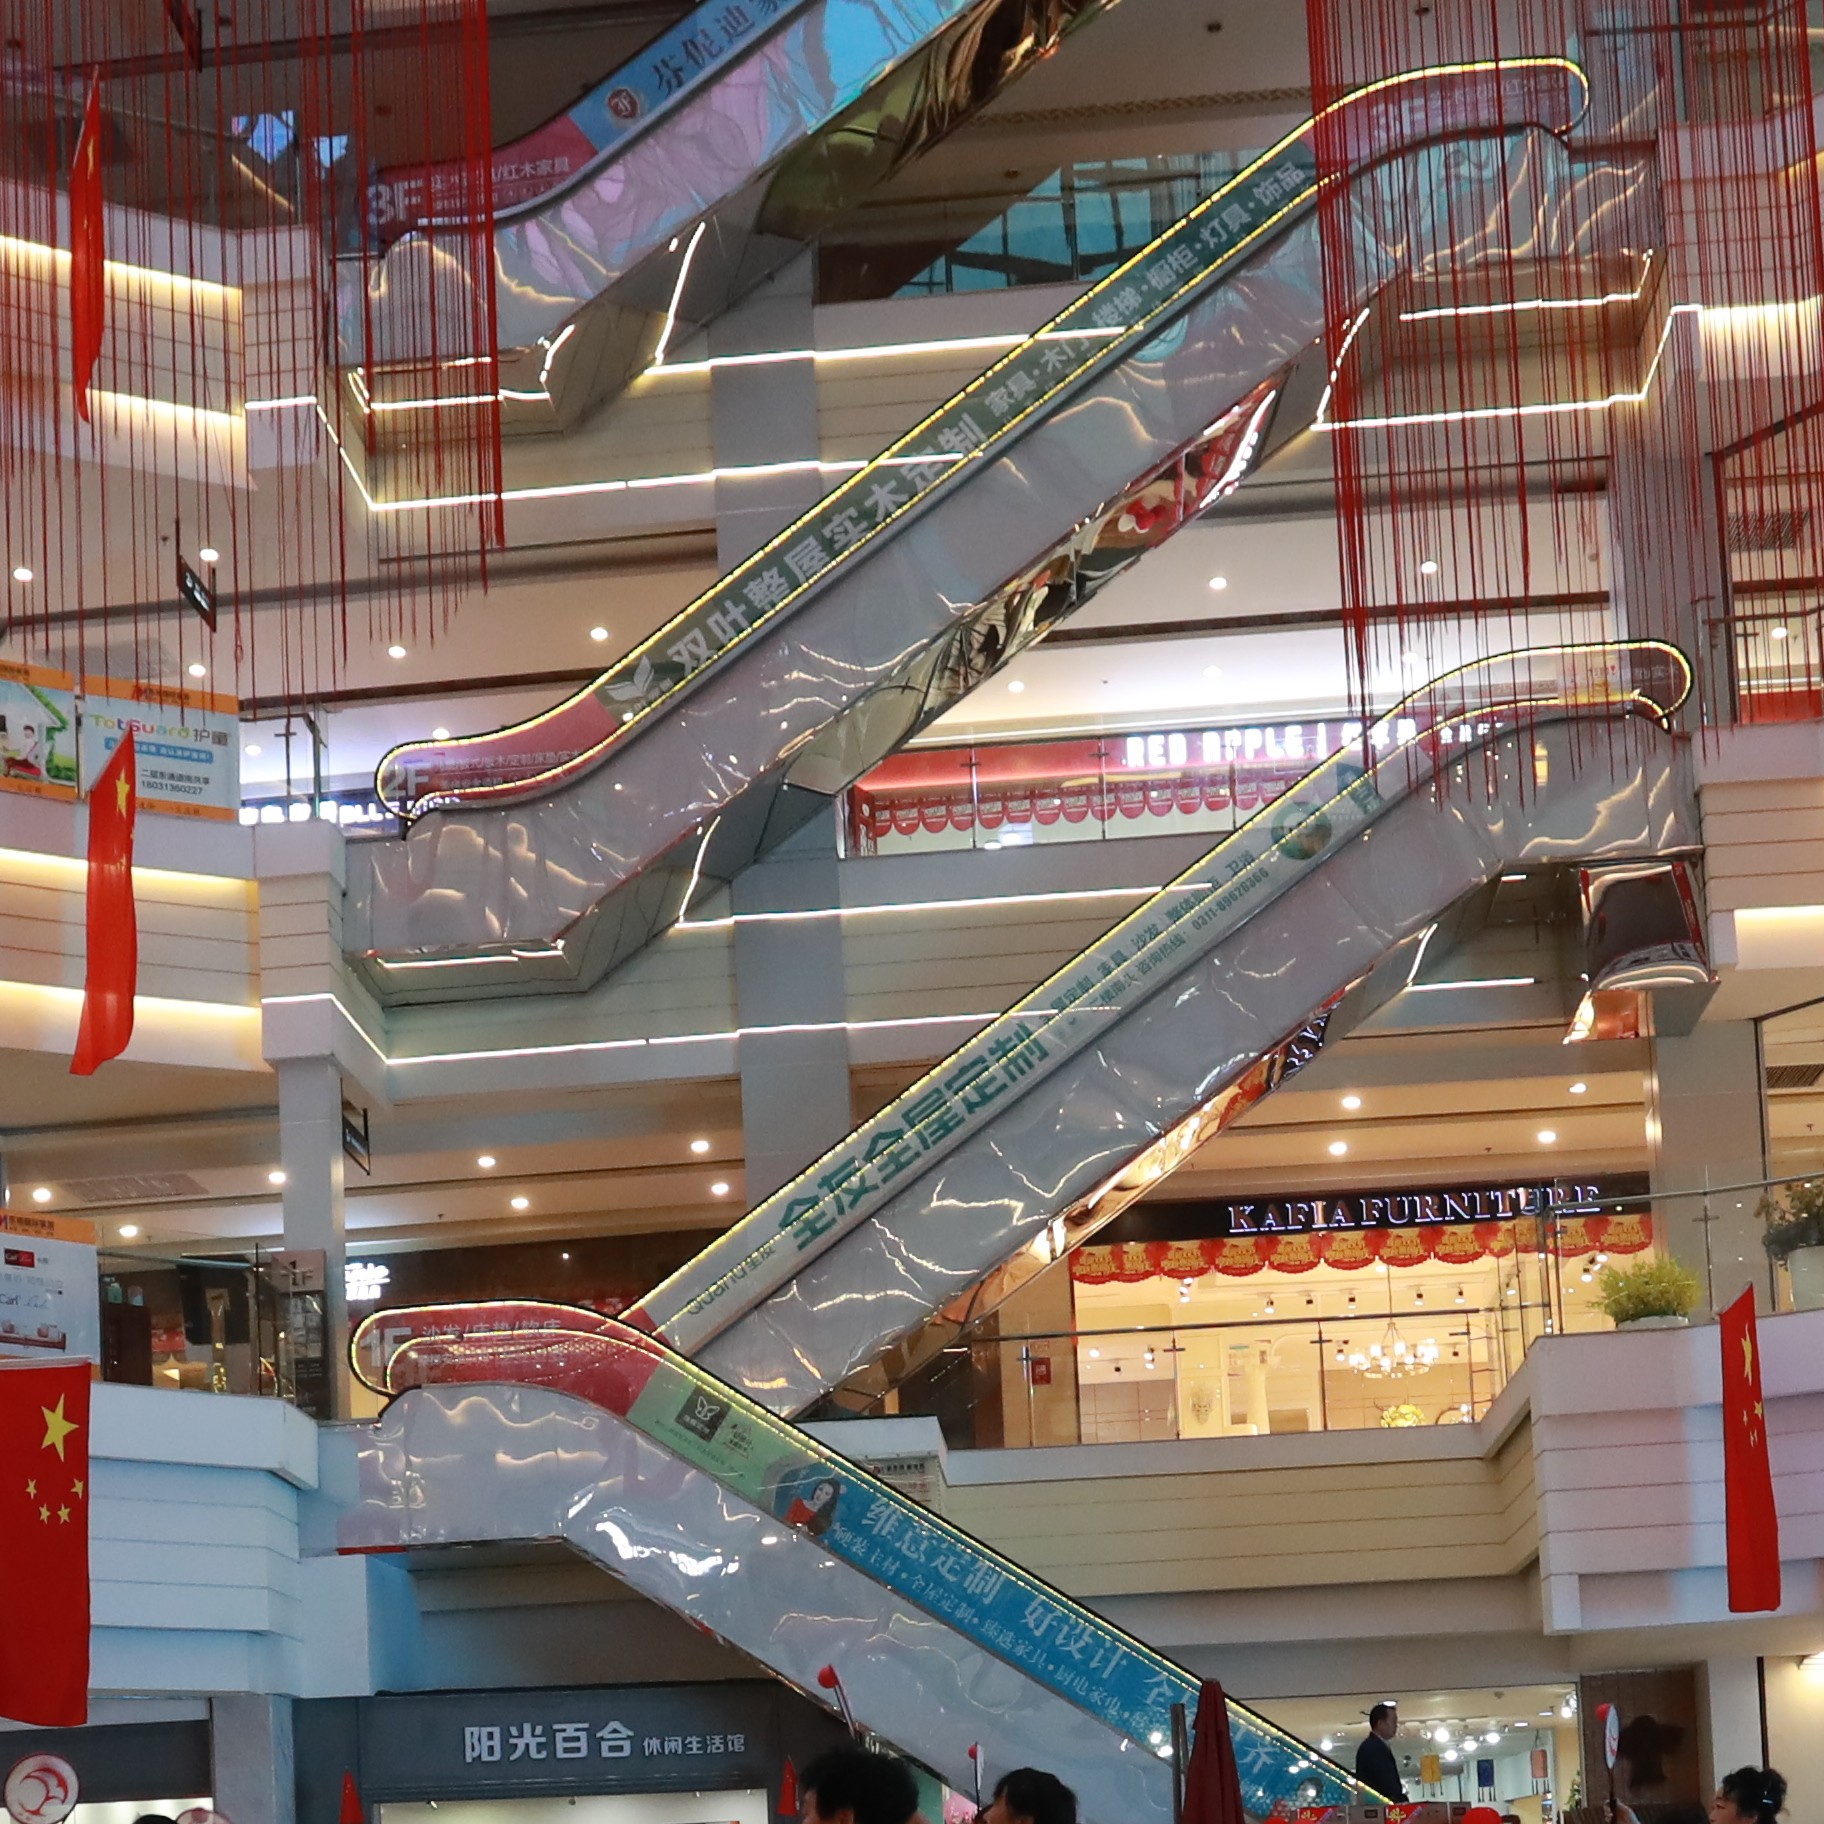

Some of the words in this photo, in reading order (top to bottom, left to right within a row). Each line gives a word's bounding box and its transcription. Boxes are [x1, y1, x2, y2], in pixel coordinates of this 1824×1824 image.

[1125, 735, 1188, 767] RED
[778, 1021, 1051, 1252] 全友全屋定制
[1227, 1200, 1355, 1234] KAFIA
[1359, 1184, 1602, 1228] FURNITURE
[862, 1496, 1007, 1606] 维意定制
[1021, 1593, 1129, 1680] 好设计
[464, 1719, 635, 1764] 阳光百合
[642, 1733, 746, 1756] 休闲生活馆
